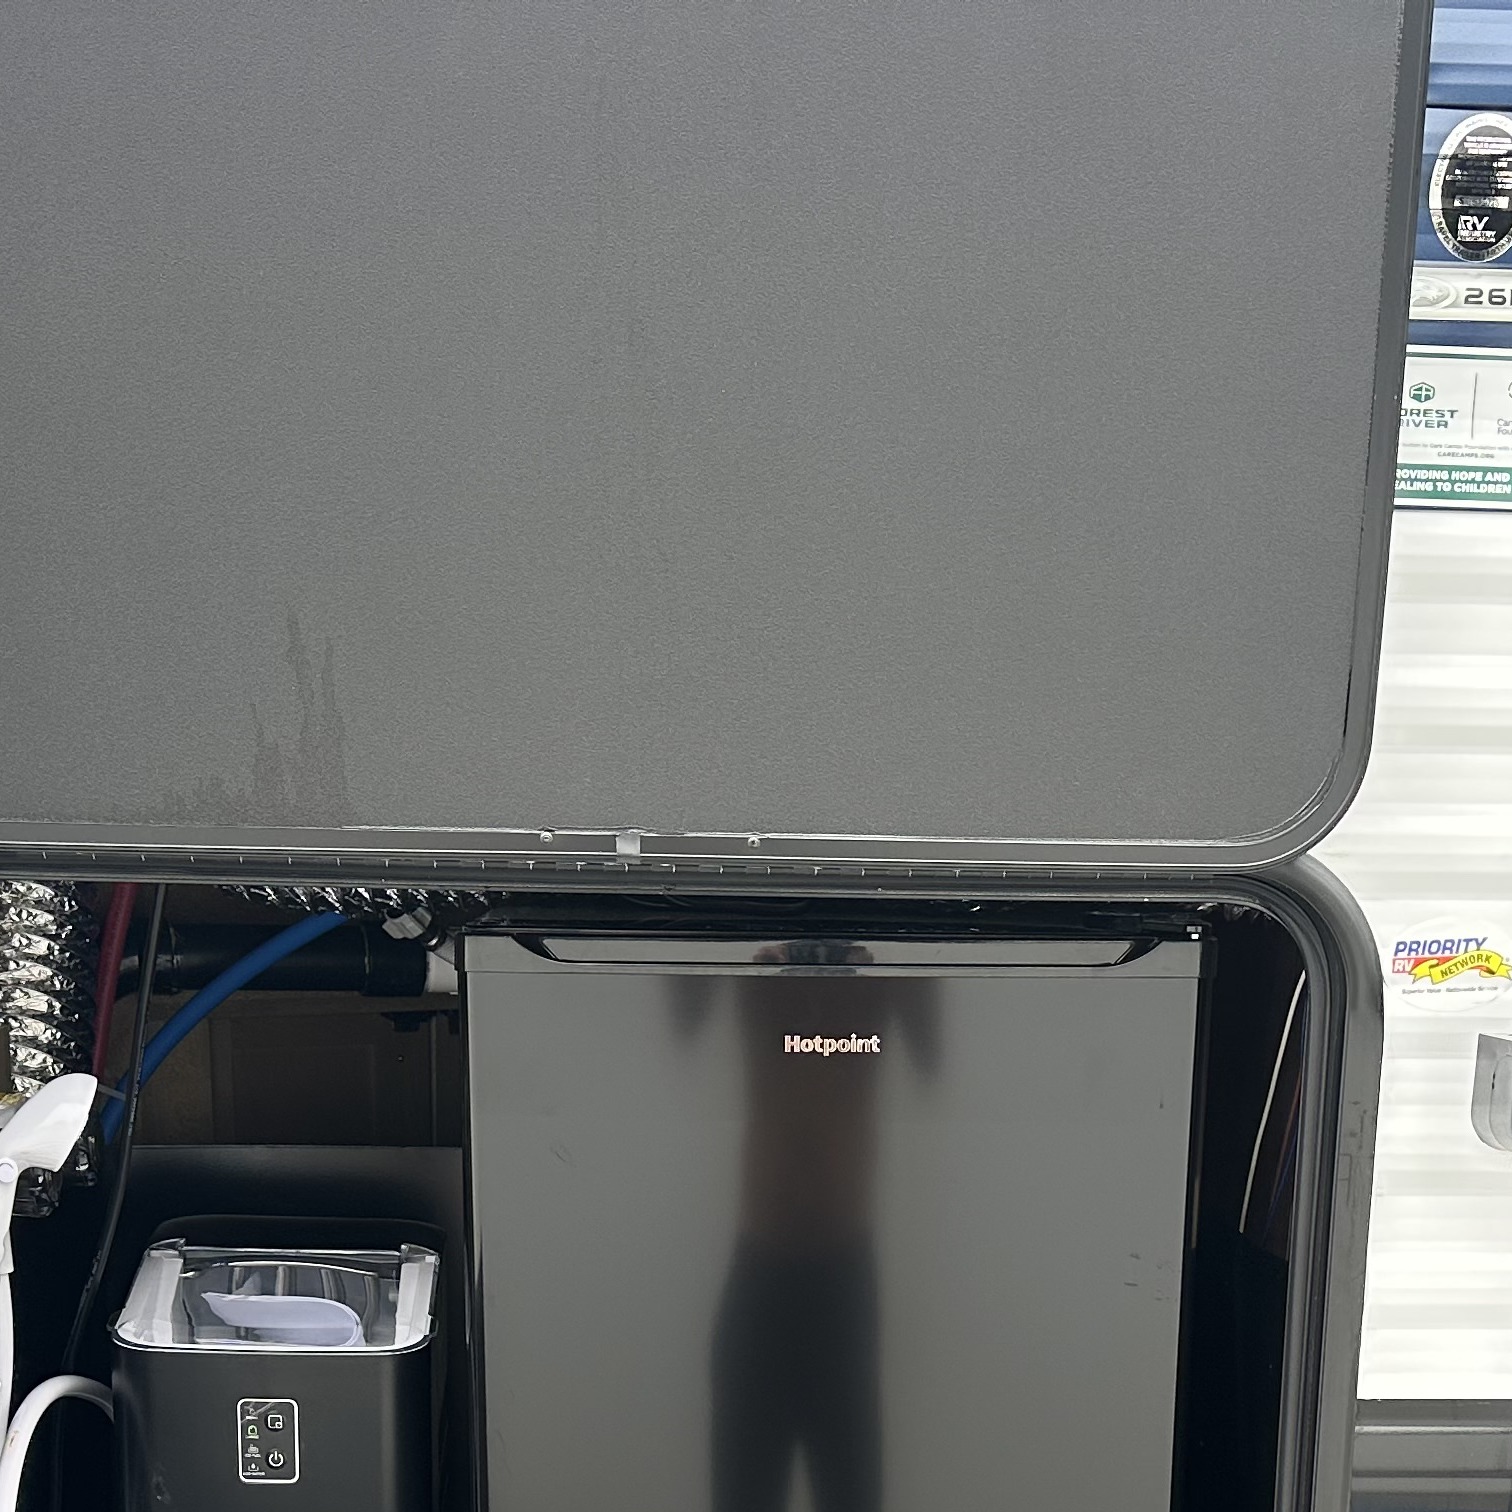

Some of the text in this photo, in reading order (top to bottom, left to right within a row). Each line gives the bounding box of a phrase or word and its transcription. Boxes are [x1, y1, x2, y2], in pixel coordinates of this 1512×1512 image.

[1458, 215, 1489, 230] RV
[1400, 408, 1459, 418] OREST
[1396, 469, 1511, 482] ROVIDING HOPE AND
[1395, 480, 1512, 494] EALING TO CHILDREN
[1393, 937, 1488, 957] PRIORITY
[1394, 959, 1415, 972] RV
[1440, 953, 1492, 979] NETWORK
[784, 1032, 881, 1057] Hotpoint
